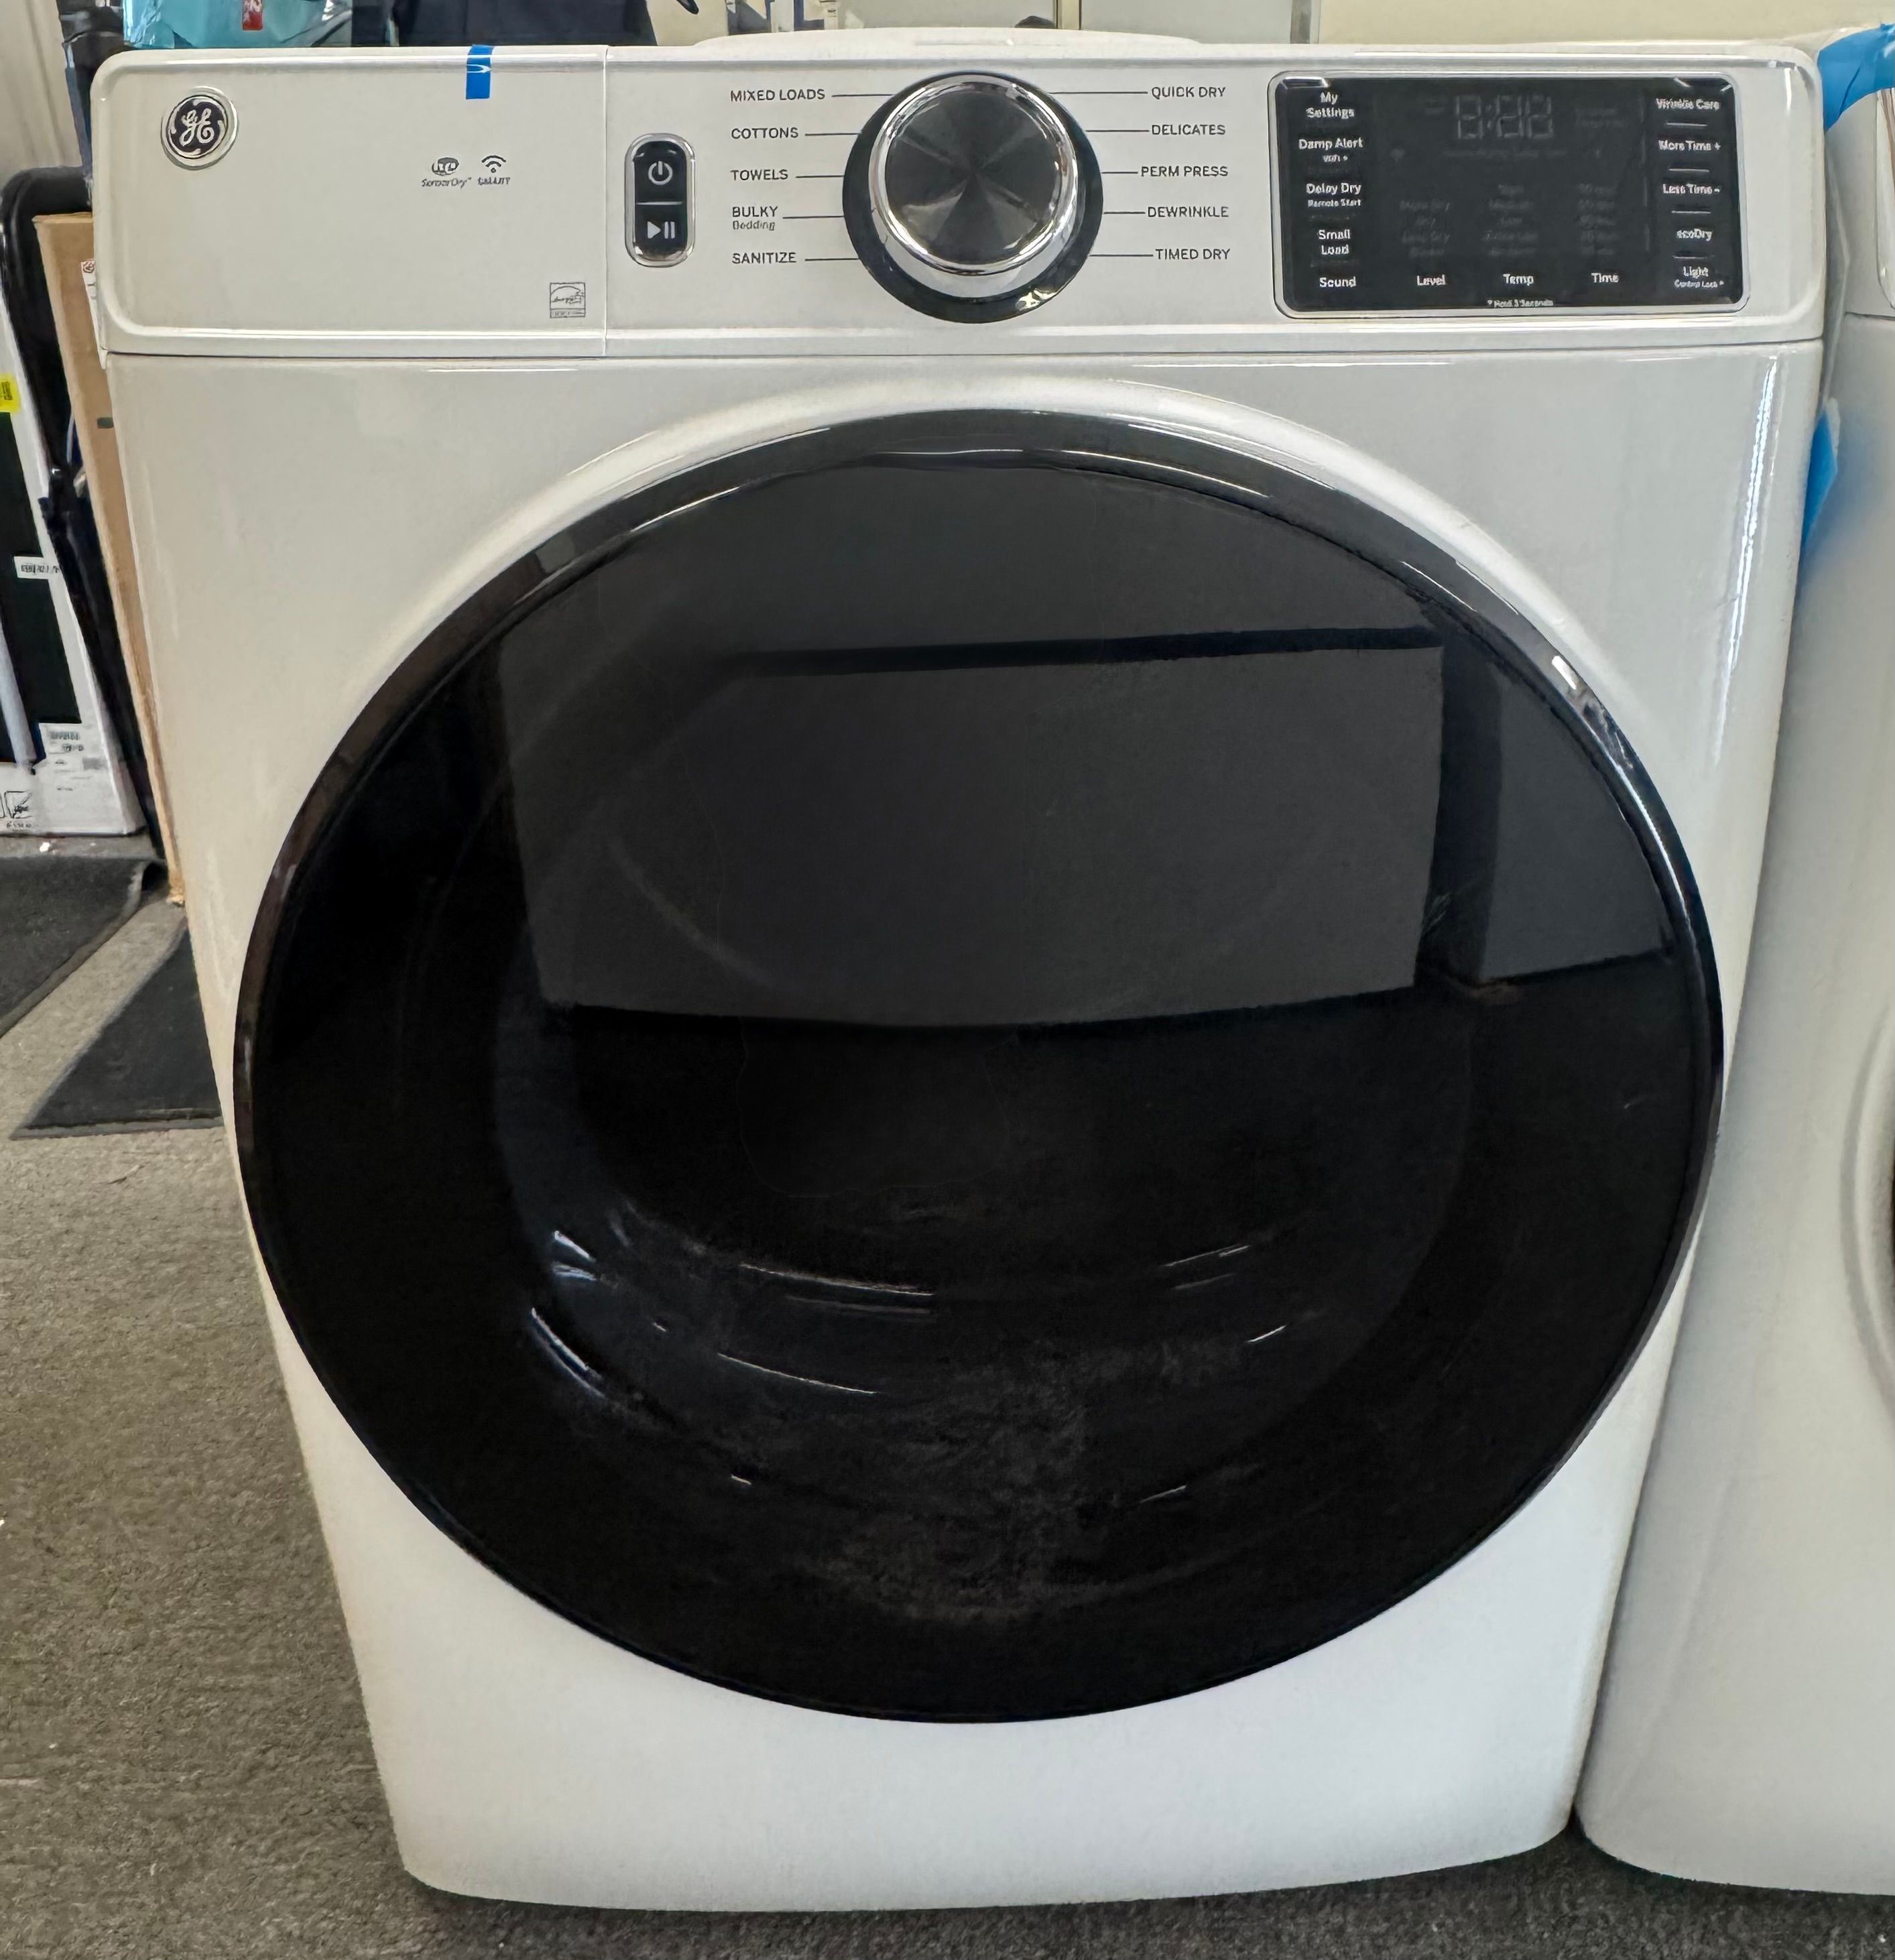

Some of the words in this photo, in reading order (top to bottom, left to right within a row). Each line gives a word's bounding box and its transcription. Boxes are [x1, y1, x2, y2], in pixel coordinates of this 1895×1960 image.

[730, 89, 776, 102] MIXED
[779, 88, 826, 101] LOADS
[1151, 86, 1195, 99] QUICK
[1199, 86, 1226, 97] DRY
[1320, 91, 1338, 105] My
[1695, 99, 1720, 111] Care
[1306, 107, 1355, 119] Settings
[731, 127, 798, 139] COTTONS
[1152, 125, 1226, 135] DELICATES
[1298, 138, 1333, 151] Damp
[1335, 137, 1363, 148] Alert
[1658, 139, 1685, 151] More
[1685, 140, 1711, 151] Time
[730, 169, 789, 181] TOWELS
[1141, 166, 1180, 177] PERM
[1183, 166, 1229, 177] PRESS
[1306, 182, 1338, 195] Delay
[1341, 182, 1361, 195] Dry
[1662, 183, 1686, 194] Less
[1686, 183, 1713, 194] Time
[731, 206, 778, 218] BULKY
[1147, 206, 1229, 218] DEWRINKLE
[1317, 229, 1351, 240] Small
[1156, 249, 1199, 260] TIMED
[1203, 249, 1231, 260] DRY
[1321, 244, 1350, 255] Load
[732, 252, 797, 264] SANITIZE
[1591, 273, 1619, 284] Time
[1683, 266, 1709, 279] Light
[1319, 276, 1357, 288] Sound
[1416, 275, 1447, 286] Level
[1502, 273, 1534, 286] Temp
